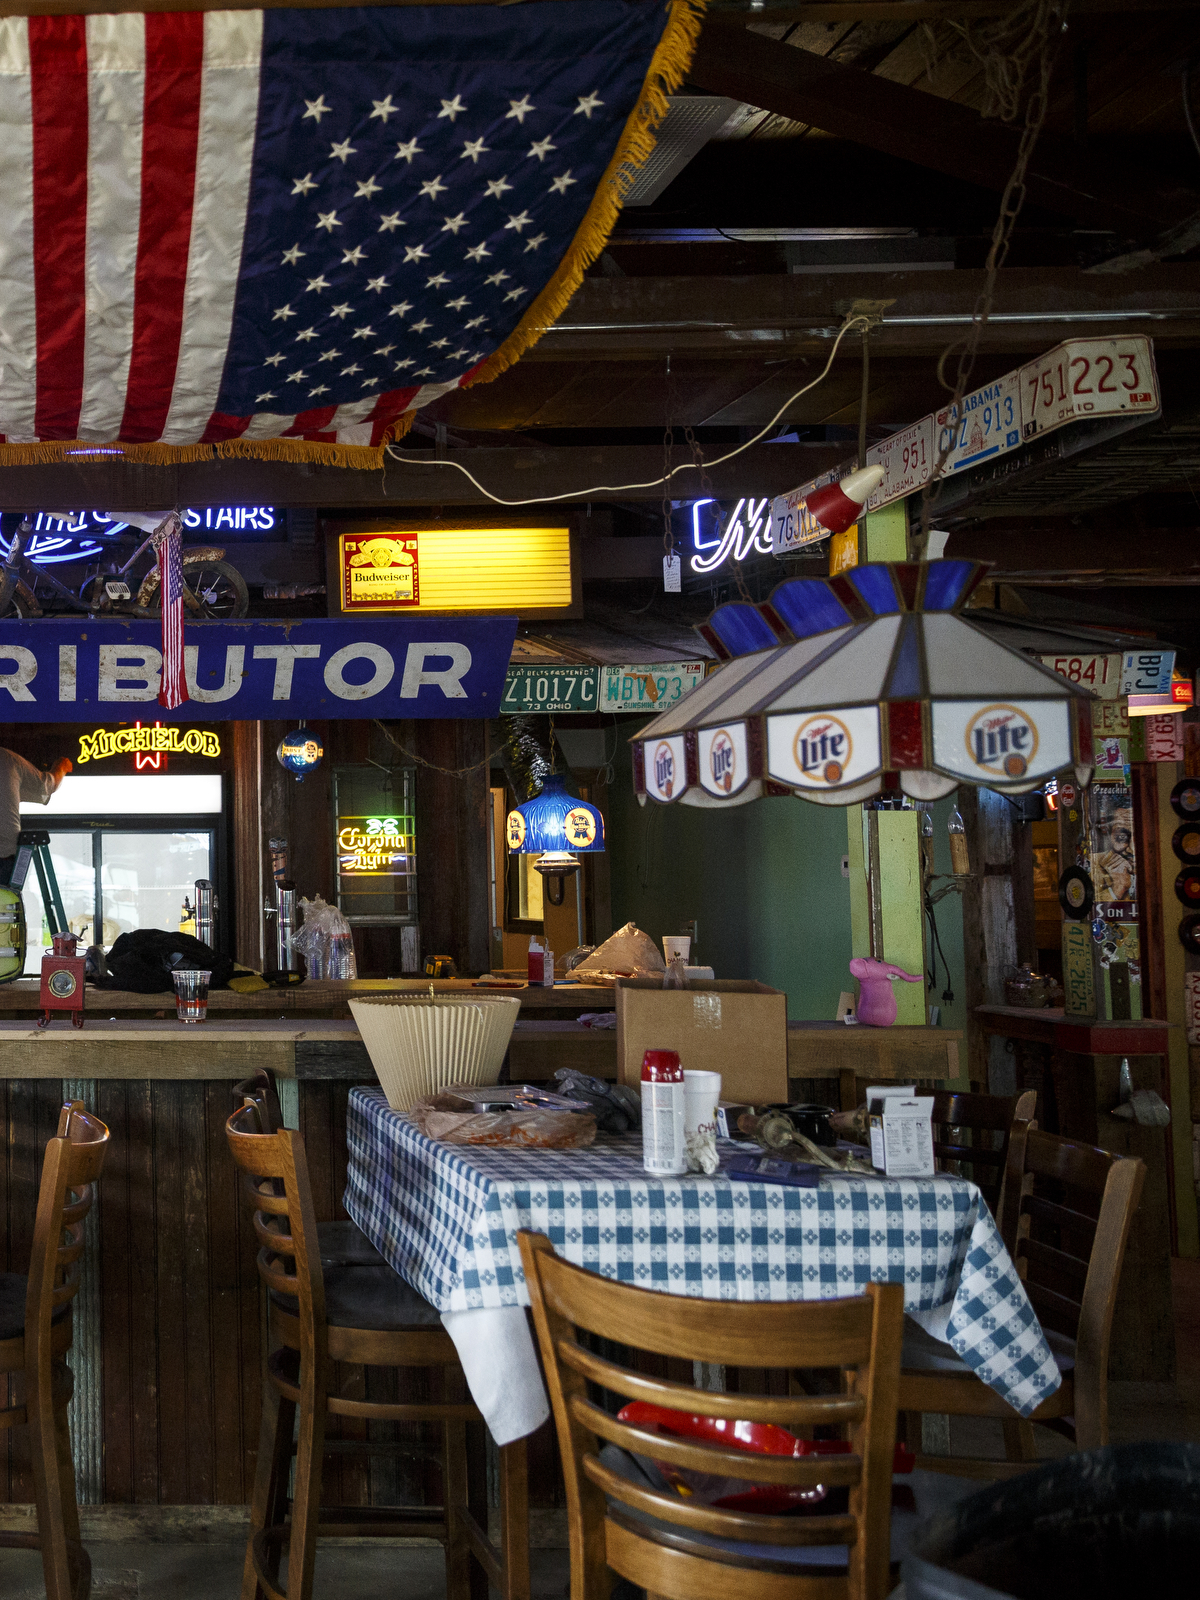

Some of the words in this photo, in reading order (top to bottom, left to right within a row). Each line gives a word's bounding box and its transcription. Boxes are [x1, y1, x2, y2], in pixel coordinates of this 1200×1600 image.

[1028, 354, 1139, 417] 751223
[951, 384, 1001, 420] AABAMA
[1058, 402, 1094, 419] OHIO
[982, 396, 1014, 436] 913
[903, 428, 918, 443] DIXIE
[902, 438, 927, 474] 951
[884, 475, 915, 500] ALABAMA
[354, 572, 410, 582] Budweiser
[527, 669, 548, 677] BELTS
[606, 668, 620, 676] DEC
[606, 676, 647, 702] WBV
[526, 703, 541, 711] 73
[623, 702, 656, 710] SUNSHINE
[77, 727, 222, 764] MICHELOB
[799, 731, 845, 772] Lite
[973, 724, 1030, 764] Lite
[656, 755, 673, 789] Lite
[712, 746, 732, 782] Lite
[338, 826, 406, 851] Corona
